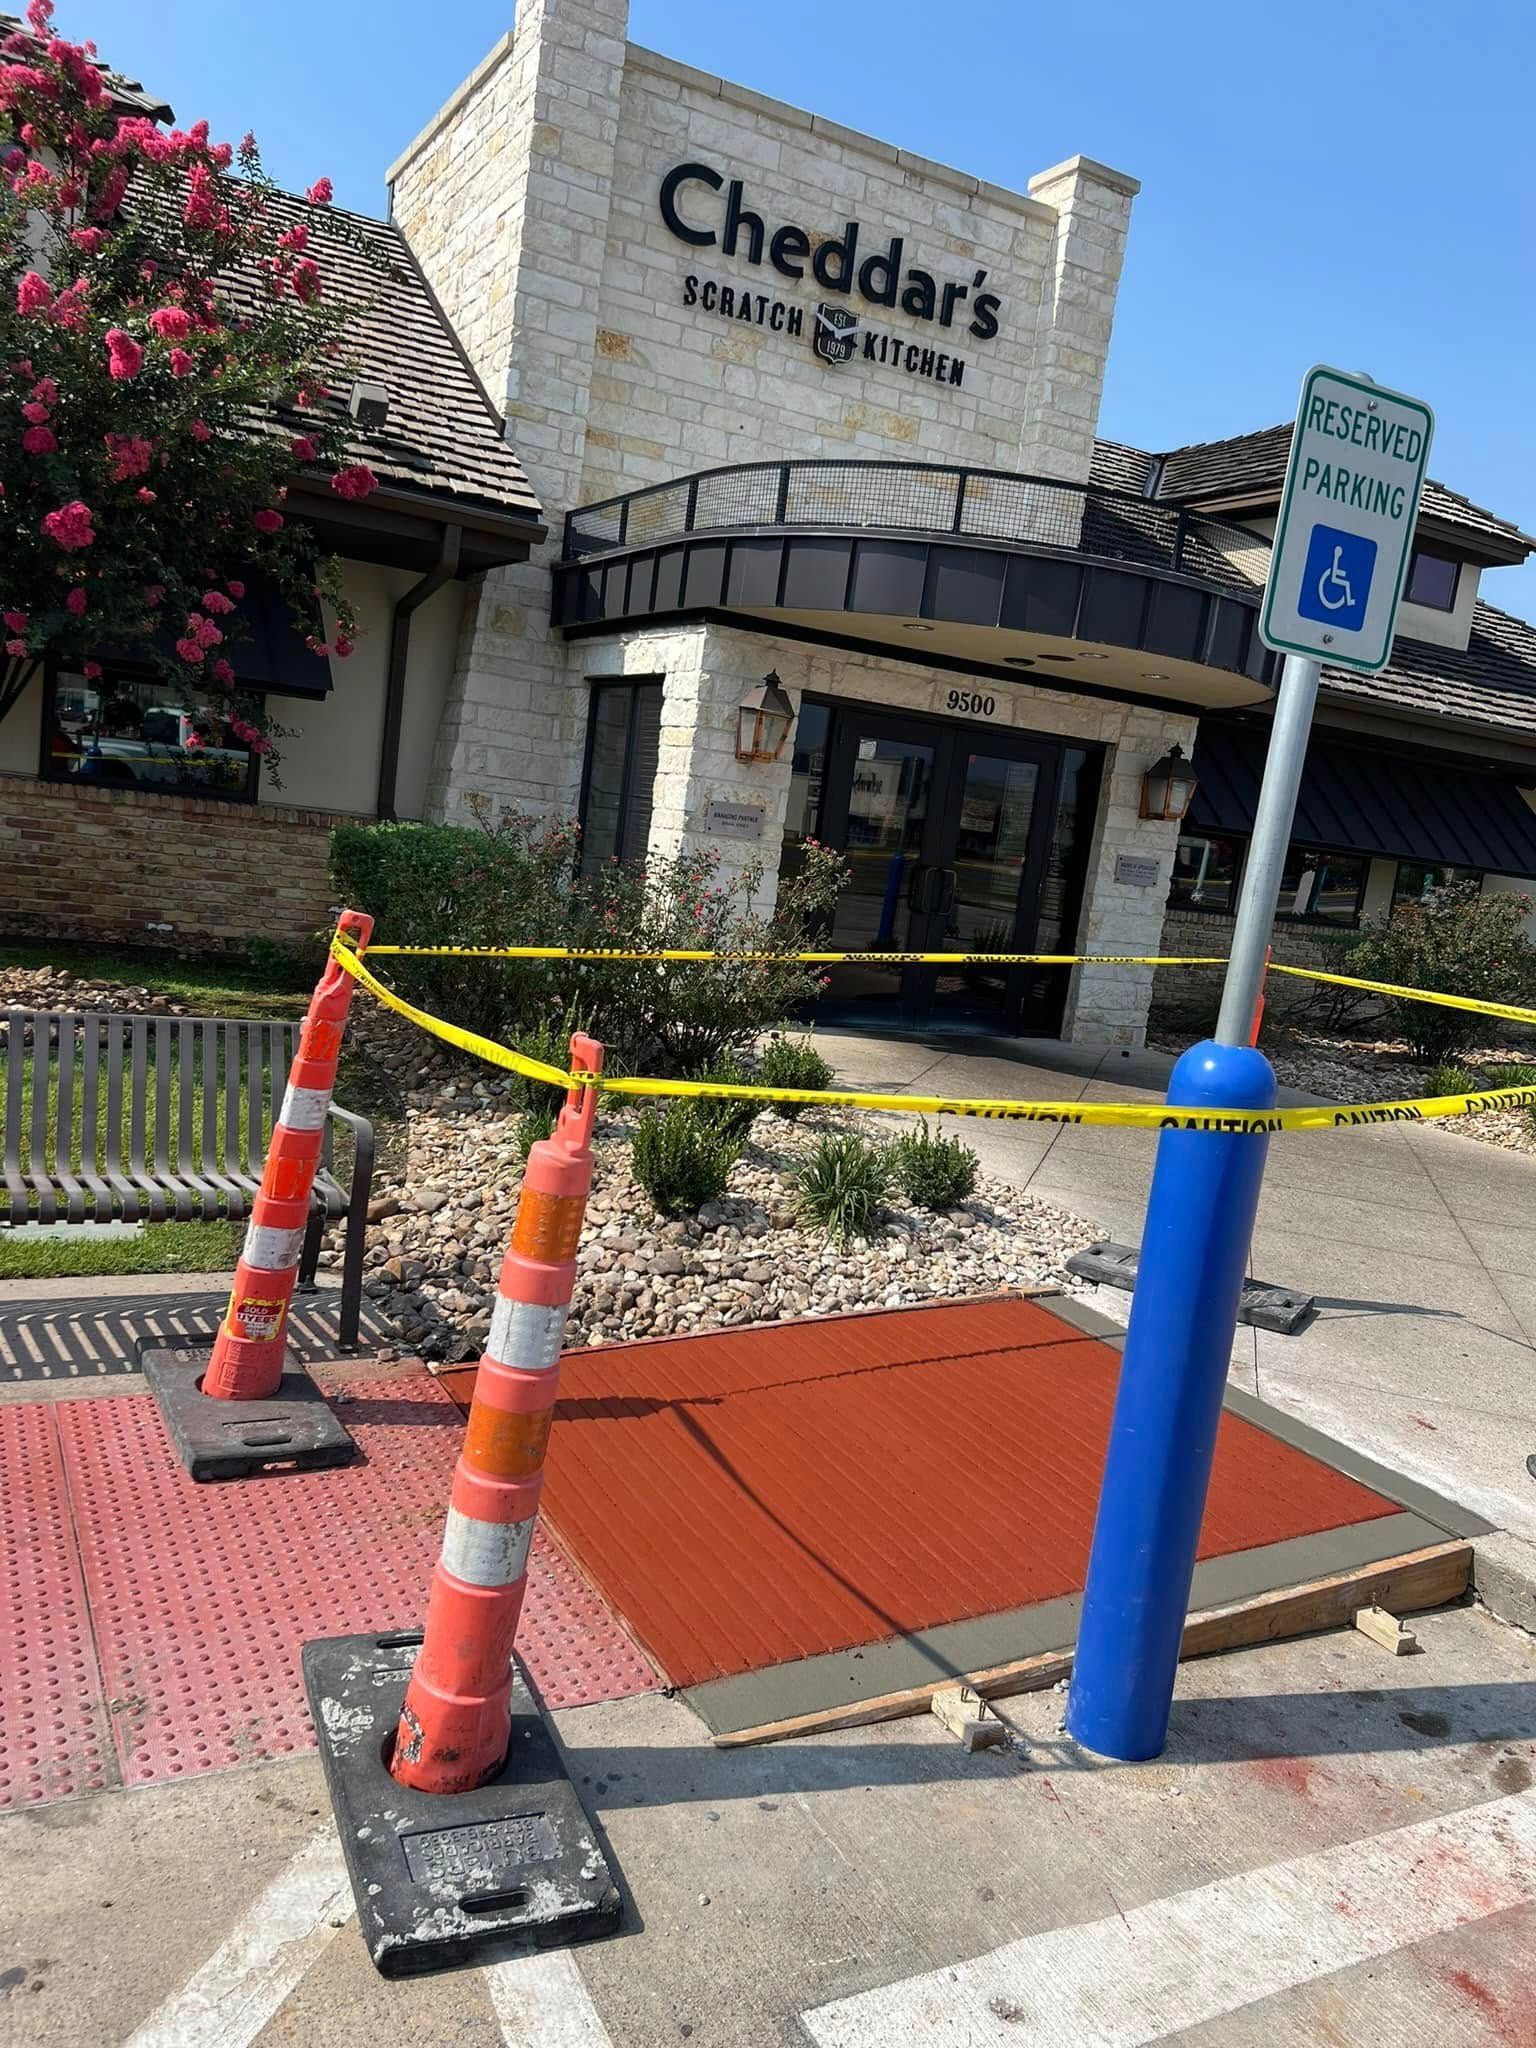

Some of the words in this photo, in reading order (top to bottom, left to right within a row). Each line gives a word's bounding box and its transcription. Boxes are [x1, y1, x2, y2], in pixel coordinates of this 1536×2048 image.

[659, 162, 1002, 340] Cheddar's
[682, 275, 803, 337] SCRATCH
[826, 340, 847, 357] 1979
[863, 331, 966, 387] KITCHEN
[1308, 395, 1422, 463] RESERVED
[1302, 457, 1405, 520] PARKING
[946, 690, 996, 717] 9500
[1465, 1090, 1536, 1114] CAUTIO
